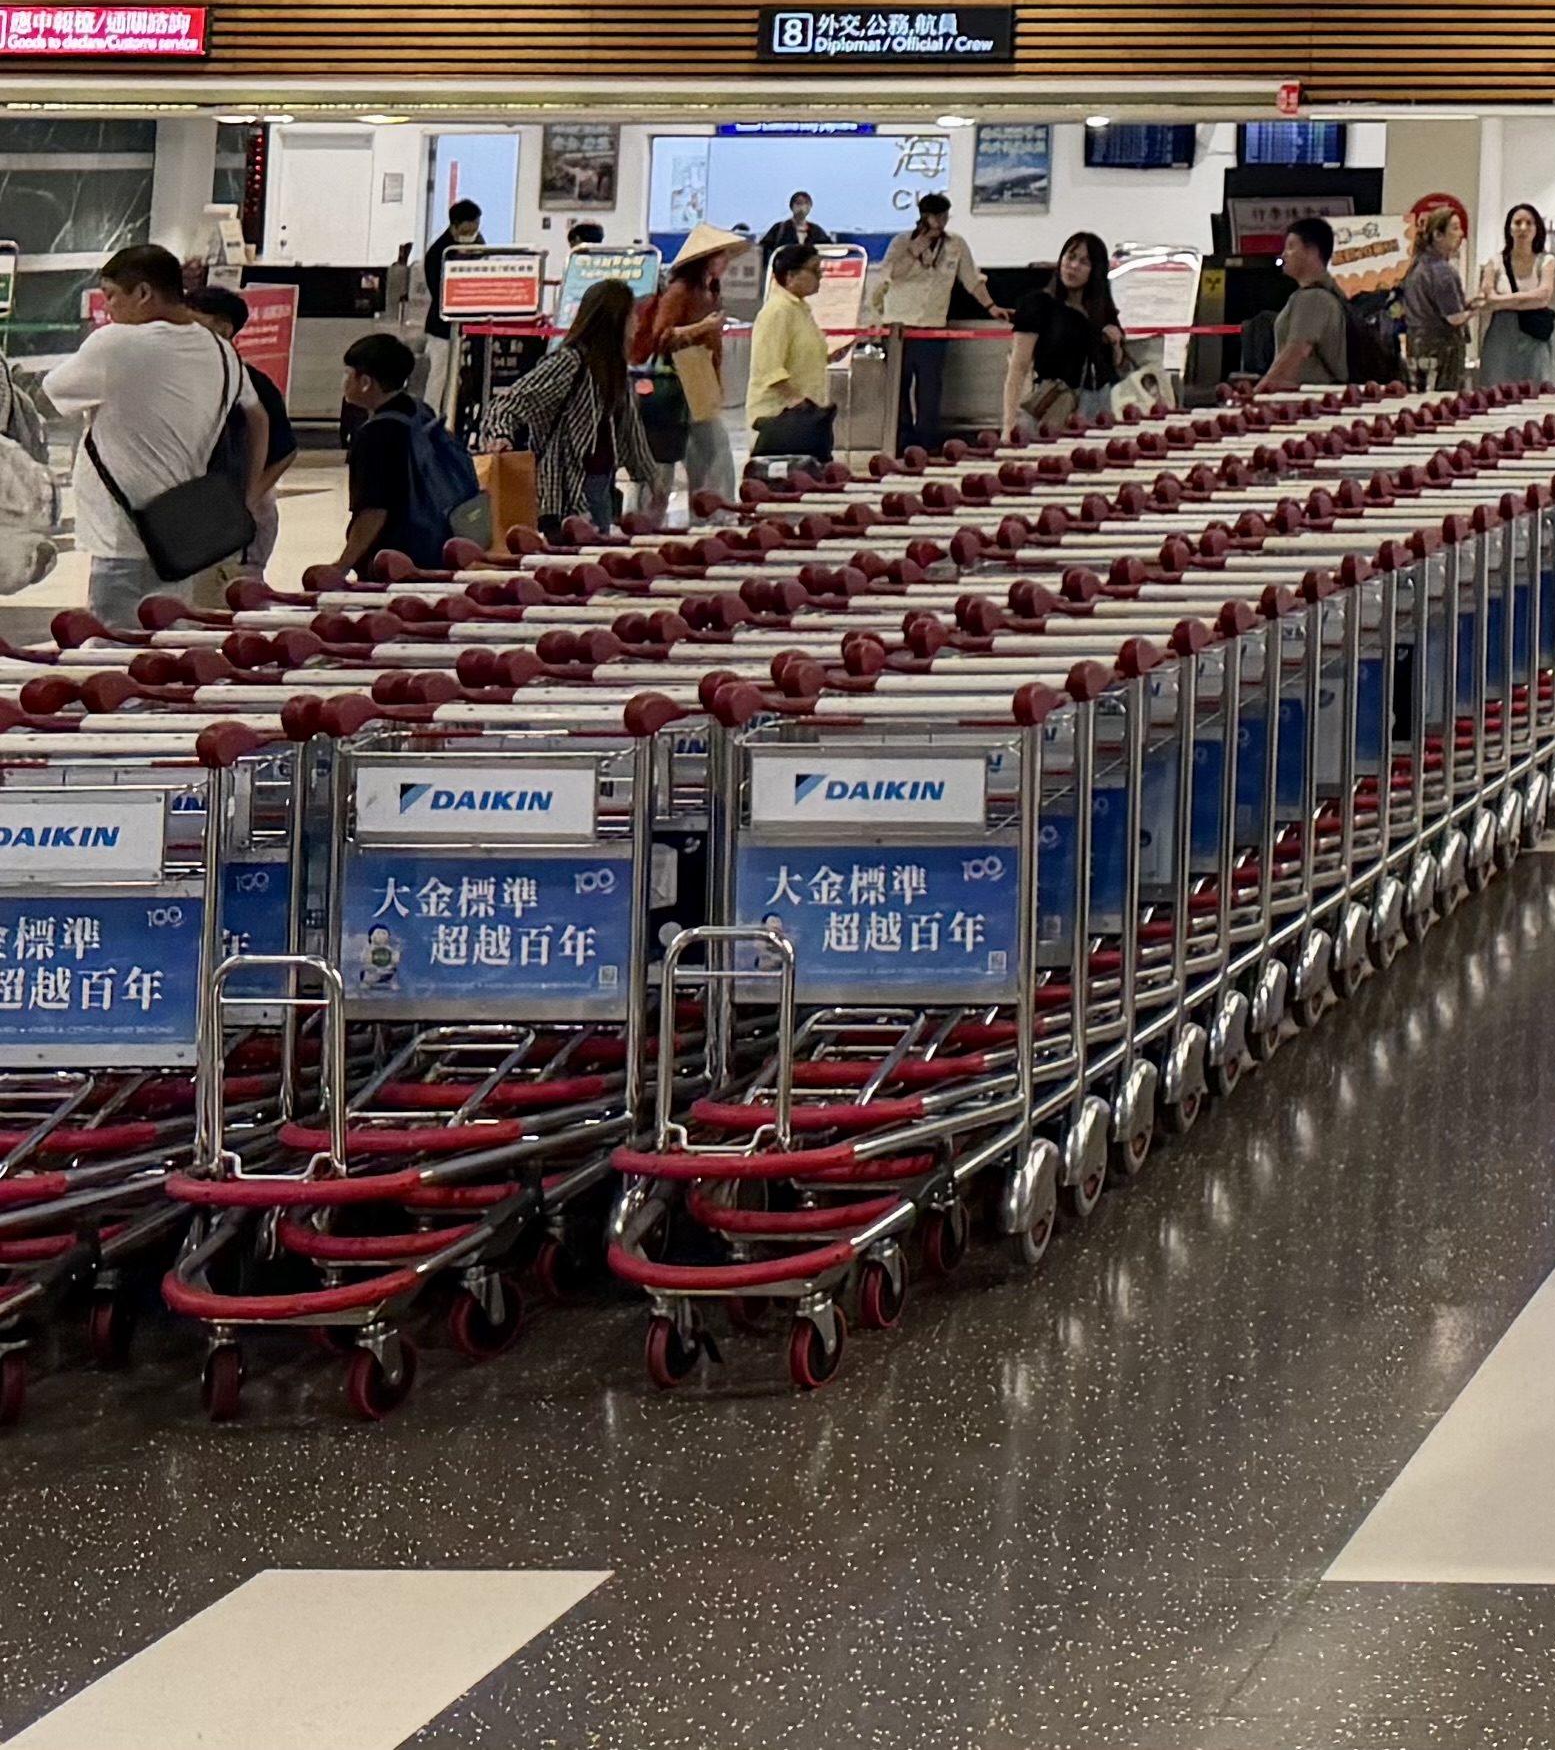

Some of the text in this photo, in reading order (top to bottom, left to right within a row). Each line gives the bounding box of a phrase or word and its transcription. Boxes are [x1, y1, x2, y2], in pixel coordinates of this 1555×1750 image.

[783, 19, 803, 46] 8
[431, 790, 552, 811] DAIKIN
[825, 780, 945, 802] DAIKIN
[372, 877, 538, 919] 大金標準
[767, 865, 927, 906] 大金標準
[0, 916, 100, 960] 標準
[431, 923, 597, 966] 超越百年
[822, 912, 986, 953] 超越百年
